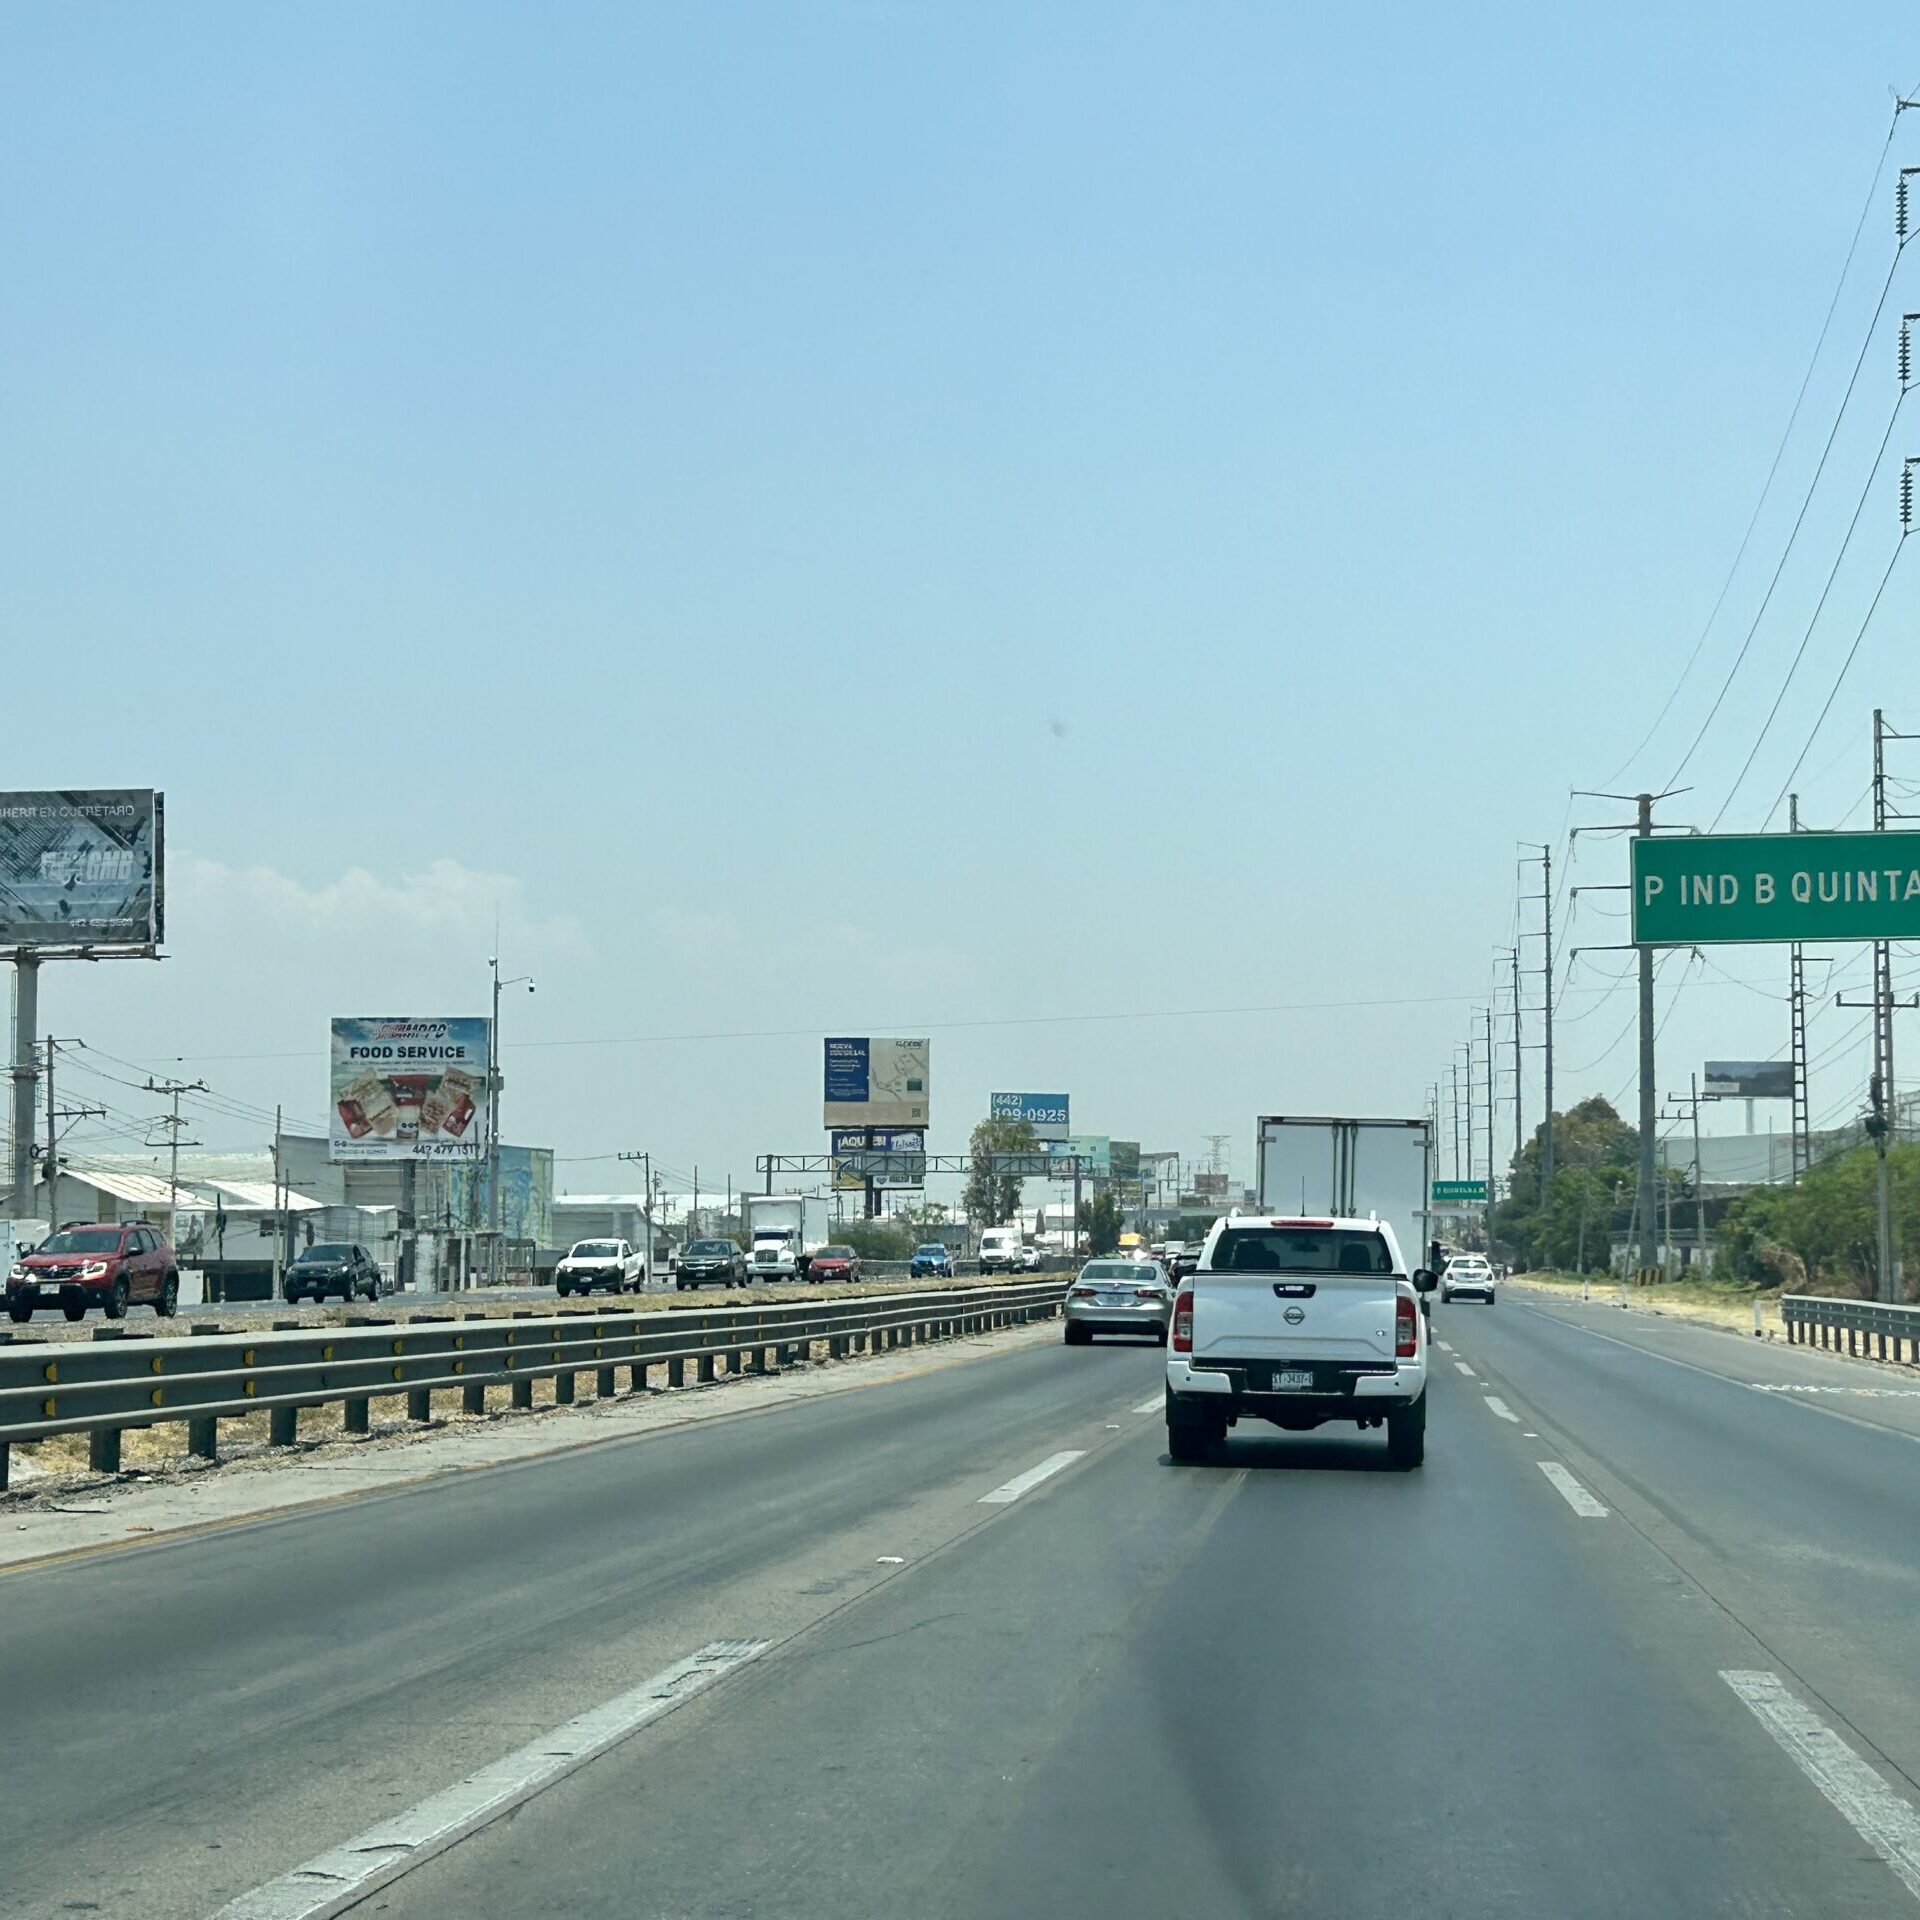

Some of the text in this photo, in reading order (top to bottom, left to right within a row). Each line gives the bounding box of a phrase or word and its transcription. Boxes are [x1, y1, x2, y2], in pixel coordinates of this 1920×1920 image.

[39, 806, 56, 818] EN
[1644, 869, 1920, 906] P IND B QUINTA
[350, 1046, 466, 1059] FOOD SERVICE
[992, 1094, 1023, 1108] (442)
